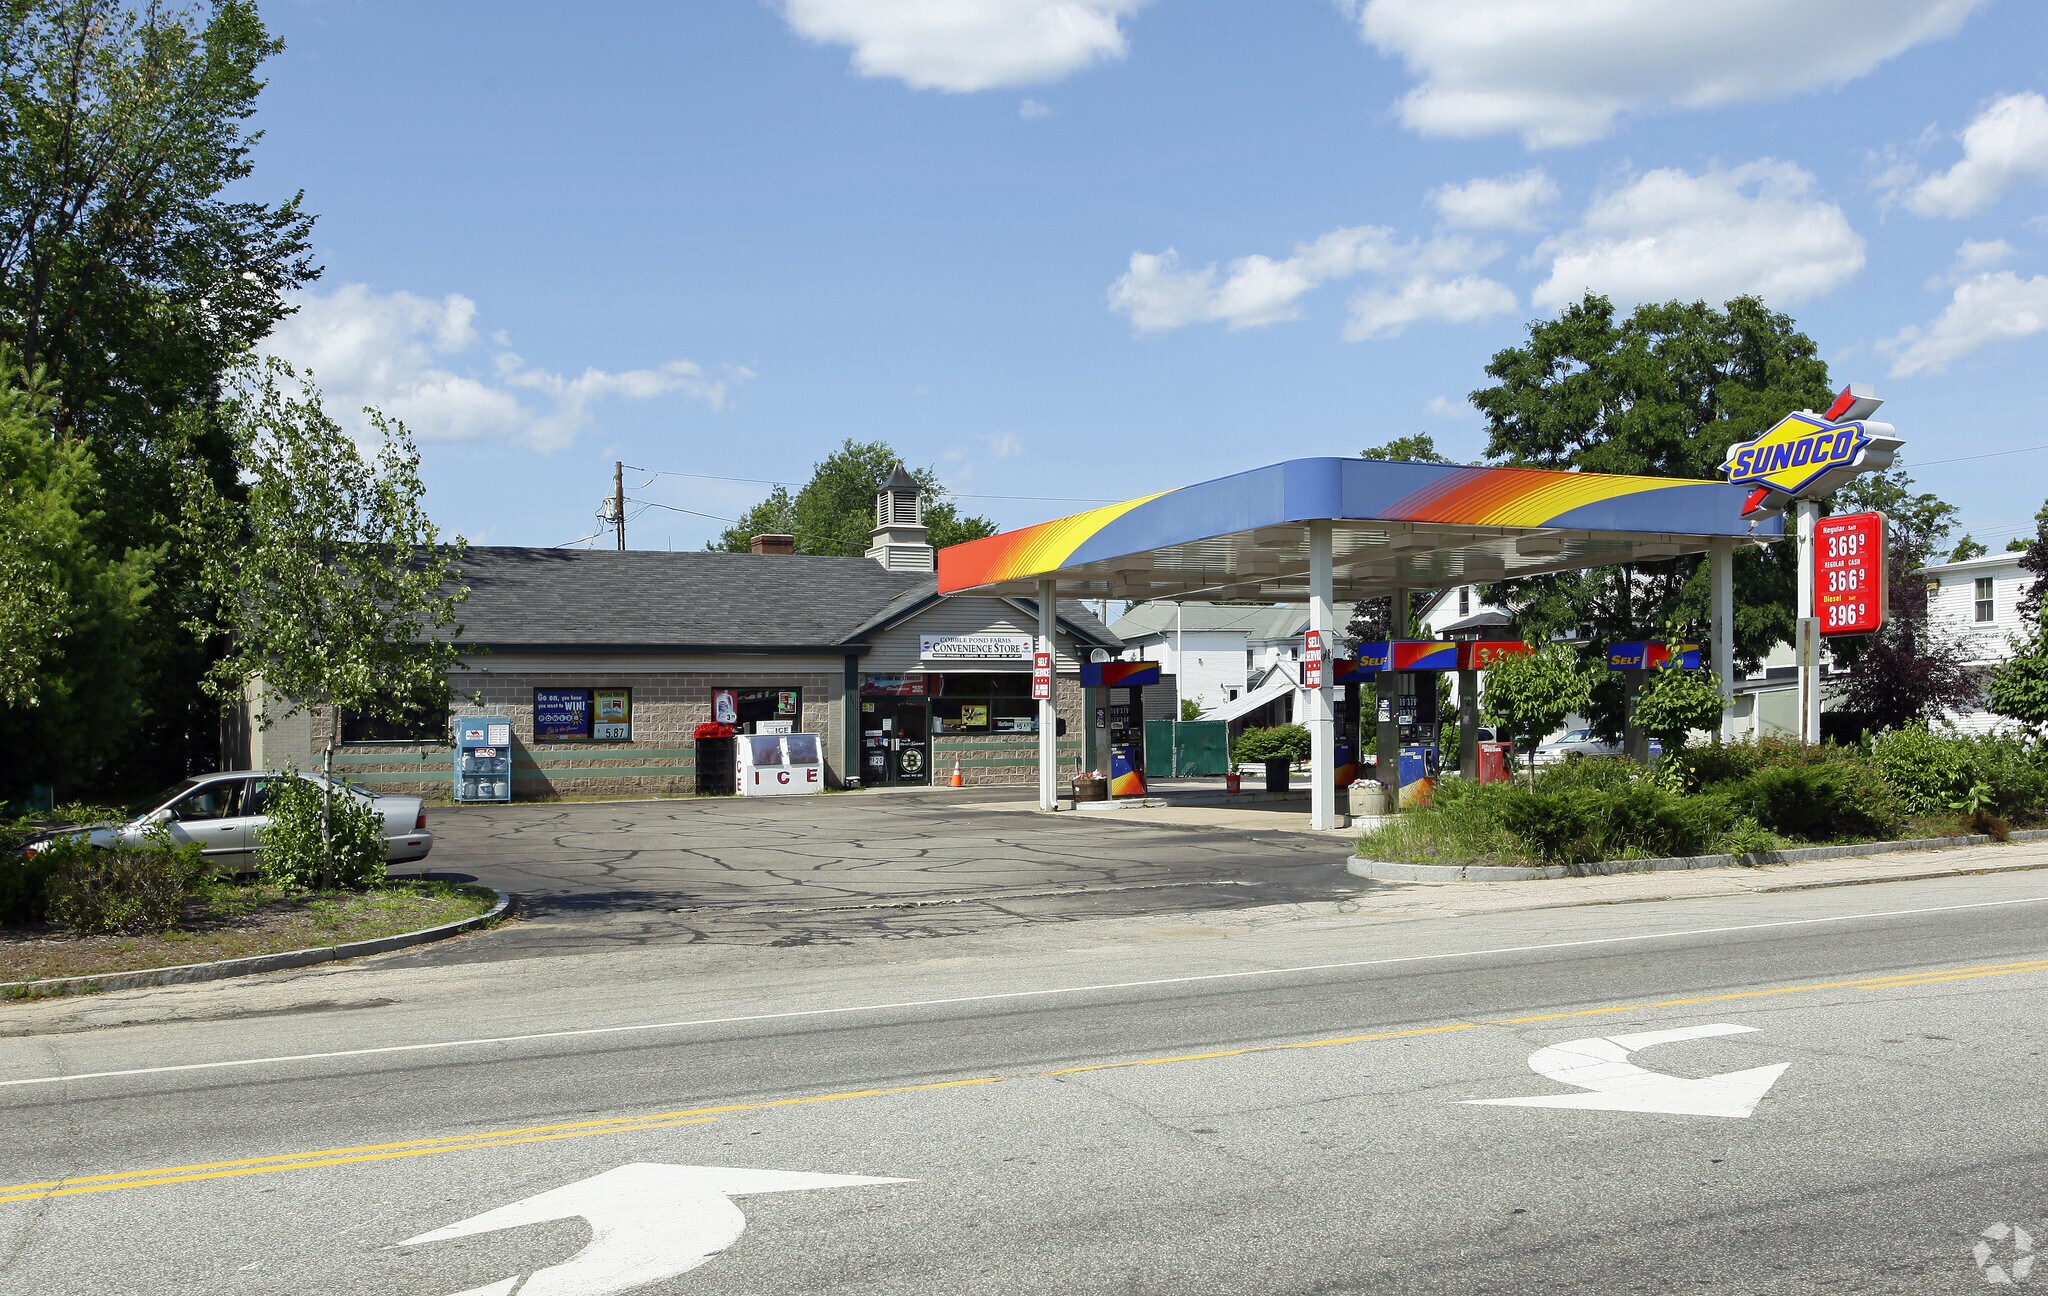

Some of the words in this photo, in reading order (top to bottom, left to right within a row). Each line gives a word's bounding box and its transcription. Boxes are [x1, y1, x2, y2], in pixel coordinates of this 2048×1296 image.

[1733, 430, 1855, 477] SUNOCO
[1823, 525, 1845, 535] Regular
[1825, 560, 1845, 569] REGULAR
[1848, 558, 1861, 566] CASH
[1824, 595, 1842, 603] Diesel
[933, 642, 993, 653] CONVENIENCE
[994, 642, 1020, 653] STORE
[1360, 655, 1387, 667] SELF
[1611, 655, 1641, 665] SELF
[537, 693, 547, 702] Go
[549, 694, 560, 702] on,
[565, 701, 586, 711] WIN!
[605, 728, 624, 738] 5.87
[775, 726, 789, 734] ICE
[755, 769, 818, 785] ICE
